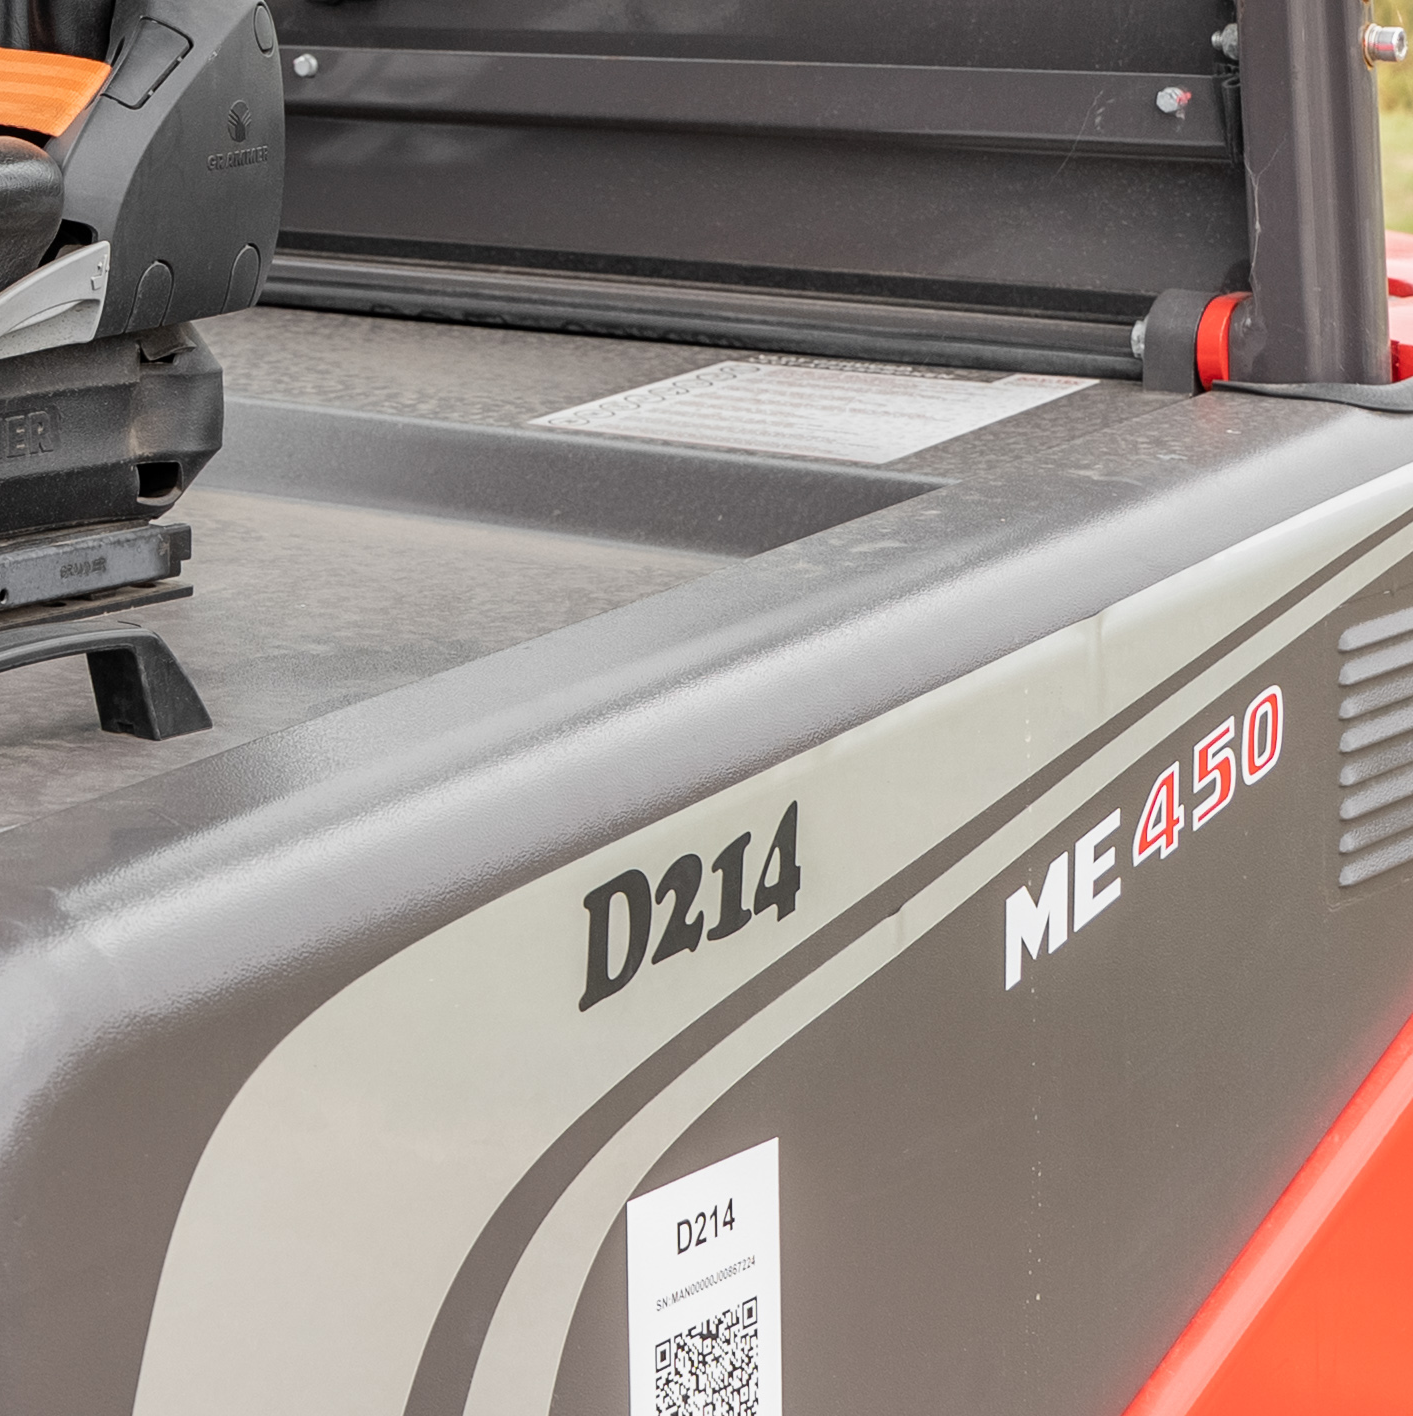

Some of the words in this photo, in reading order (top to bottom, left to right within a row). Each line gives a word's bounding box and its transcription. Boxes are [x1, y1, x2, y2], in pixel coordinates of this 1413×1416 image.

[206, 145, 268, 172] GRAMMER
[578, 799, 802, 1013] D214
[1005, 807, 1122, 992] ME
[1132, 684, 1284, 868] 450
[676, 1197, 736, 1255] D214
